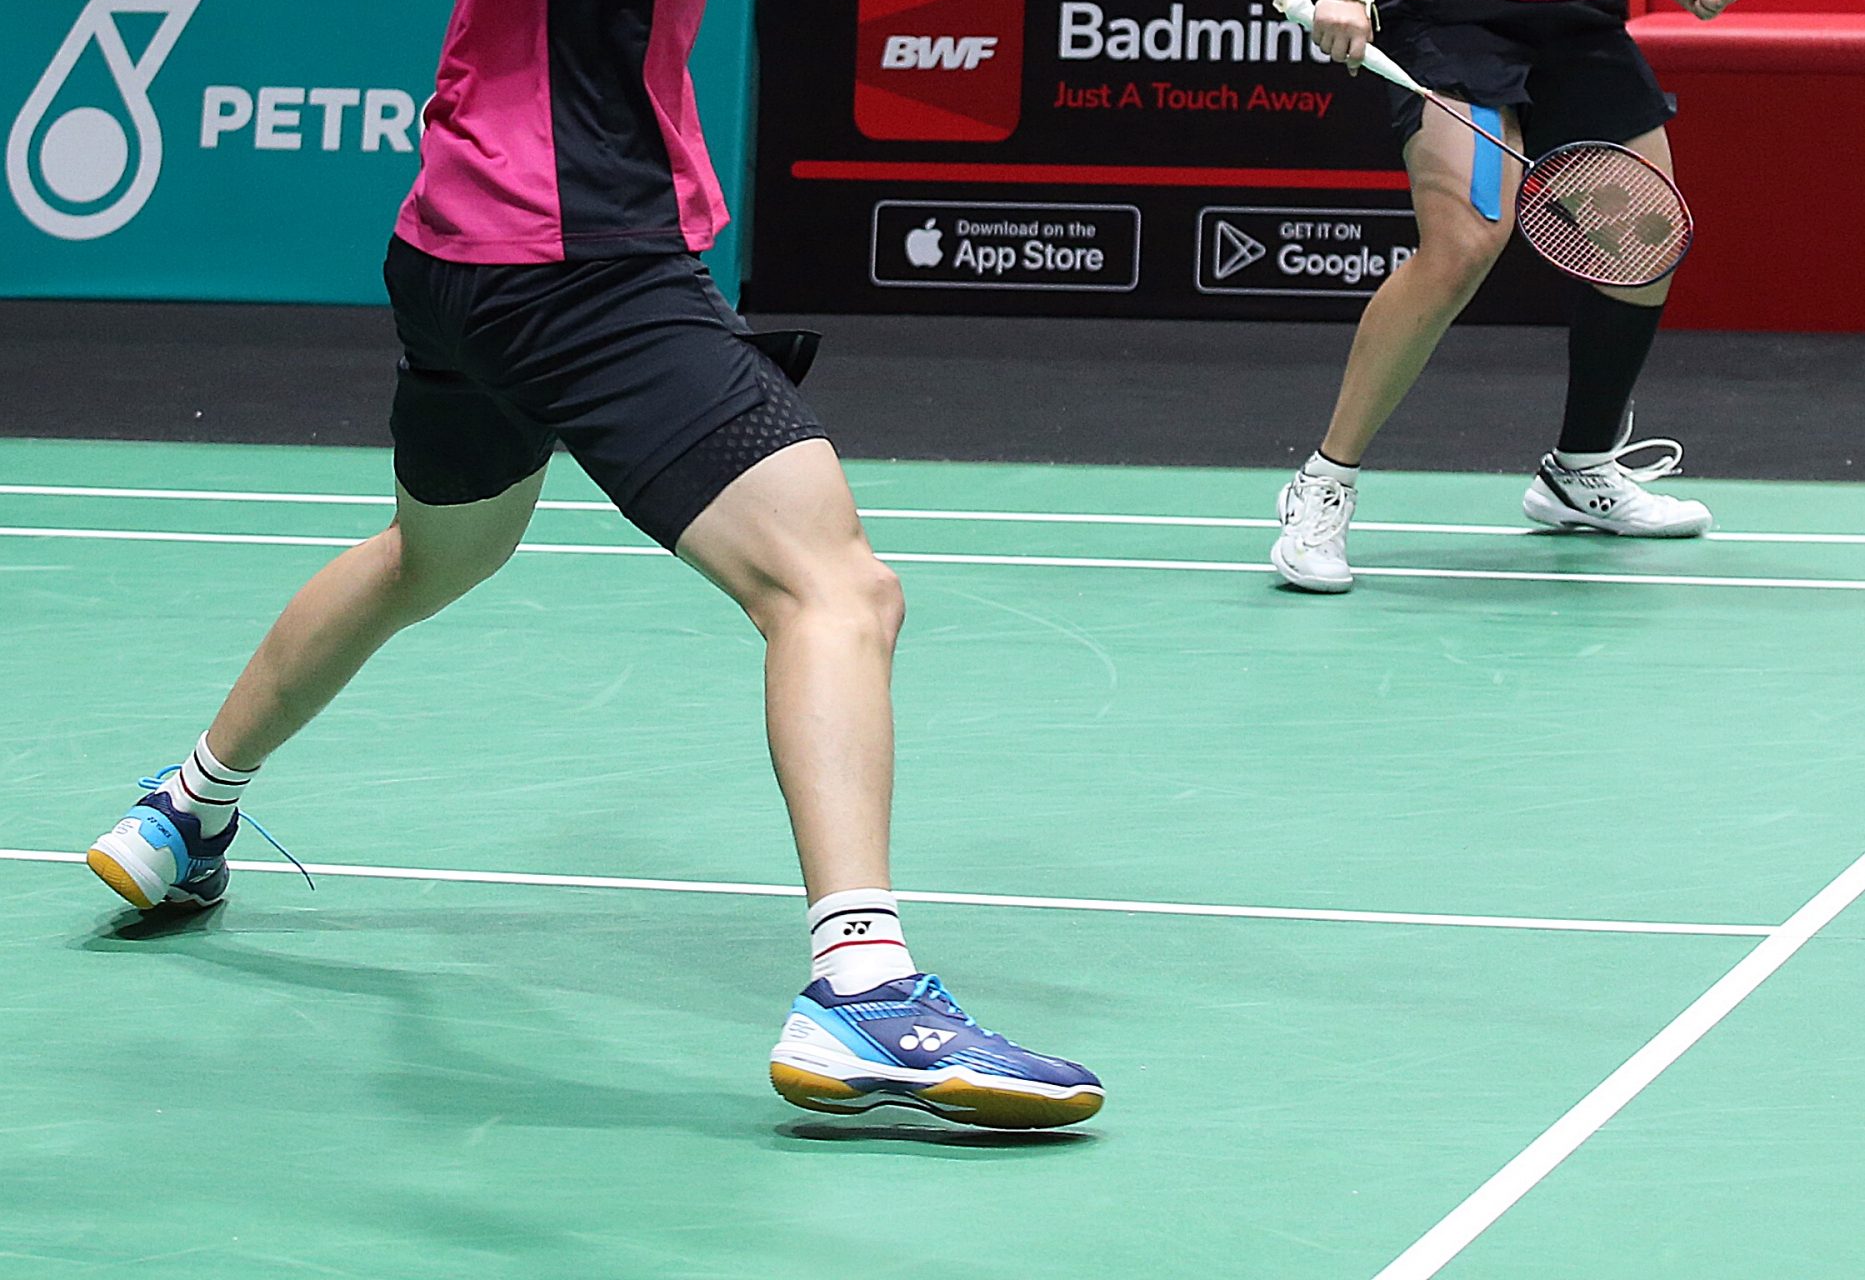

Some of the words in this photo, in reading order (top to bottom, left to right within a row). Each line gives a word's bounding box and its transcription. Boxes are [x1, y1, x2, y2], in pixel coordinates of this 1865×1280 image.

[881, 35, 999, 70] BWF
[1053, 81, 1111, 108] Just
[1119, 82, 1143, 109] A
[1151, 82, 1239, 111] Touch
[1247, 84, 1333, 117] Away
[200, 85, 437, 152] PETR
[956, 220, 1038, 237] Download
[1043, 224, 1064, 237] on
[1069, 222, 1096, 237] the
[1279, 222, 1313, 240] GET
[1317, 223, 1331, 240] IT
[1334, 223, 1362, 241] ON
[954, 239, 1017, 275] App
[1022, 240, 1104, 271] Store
[1277, 243, 1386, 284] Google
